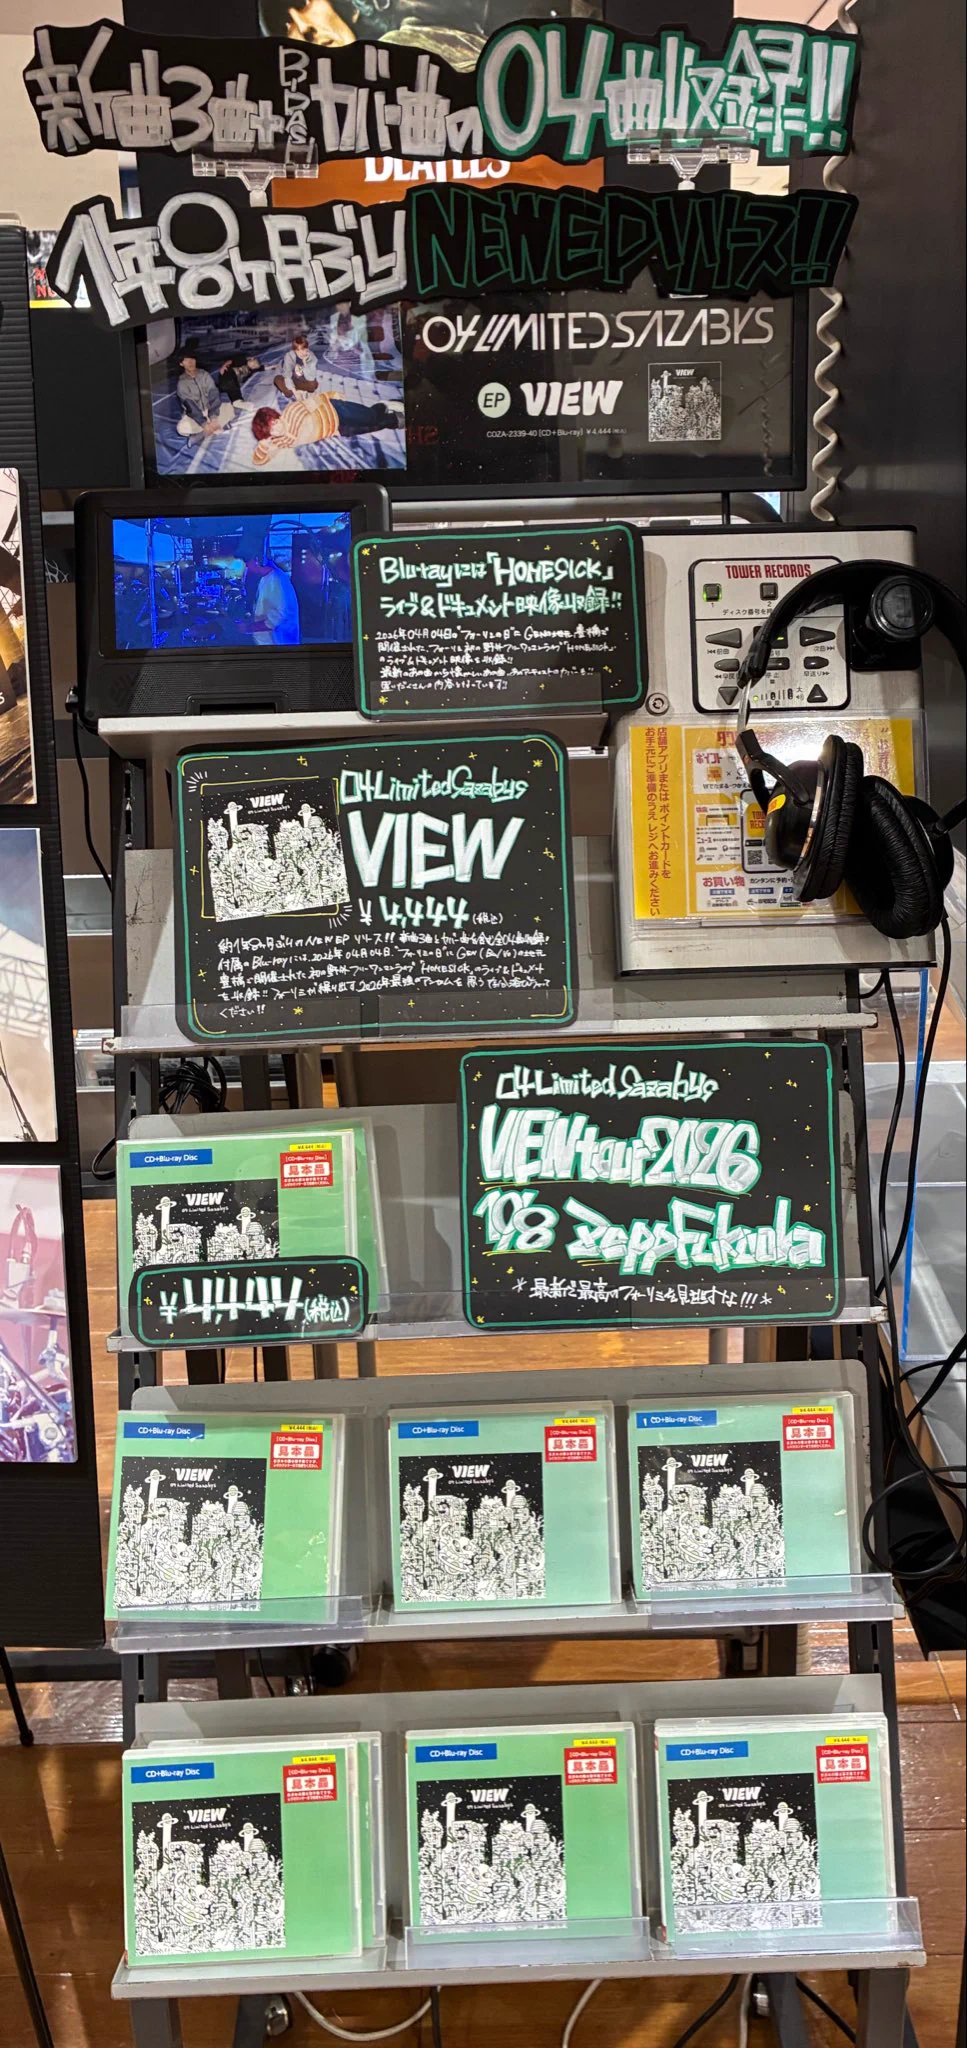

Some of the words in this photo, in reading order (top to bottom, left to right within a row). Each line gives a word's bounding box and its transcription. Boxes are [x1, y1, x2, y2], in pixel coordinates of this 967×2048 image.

[483, 393, 505, 408] EP
[520, 380, 623, 416] VIEW
[725, 564, 762, 579] TOWER
[764, 563, 811, 579] RECORDS
[250, 793, 285, 809] VIEW
[347, 810, 525, 890] VIEW
[702, 876, 745, 888] お買い物
[144, 1154, 182, 1164] CD+Blu-ray
[183, 1153, 198, 1162] Disc
[288, 1164, 325, 1176] 見本品
[185, 1192, 224, 1206] VIEW
[138, 1427, 174, 1436] CD+Blu-ray
[176, 1427, 191, 1435] Disc
[412, 1427, 449, 1435] CD+Blu-ray
[450, 1426, 465, 1434] Disc
[791, 1427, 827, 1438] 見本品
[552, 1438, 589, 1450] 見本品
[278, 1445, 315, 1457] 見本品
[690, 1454, 729, 1467] VIEW
[175, 1468, 213, 1481] VIEW
[451, 1464, 490, 1478] VIEW
[430, 1749, 467, 1758] CD+Blu-ray
[680, 1749, 718, 1757] CD+Blu-ray
[719, 1747, 734, 1755] Disc
[573, 1760, 609, 1771] 見本品
[825, 1758, 862, 1770] 見本品
[145, 1771, 183, 1779] CD+Blu-ray
[291, 1777, 329, 1790] 見本品
[471, 1788, 509, 1803] VIEW
[722, 1786, 761, 1801] VIEW
[187, 1808, 226, 1823] VIEW
